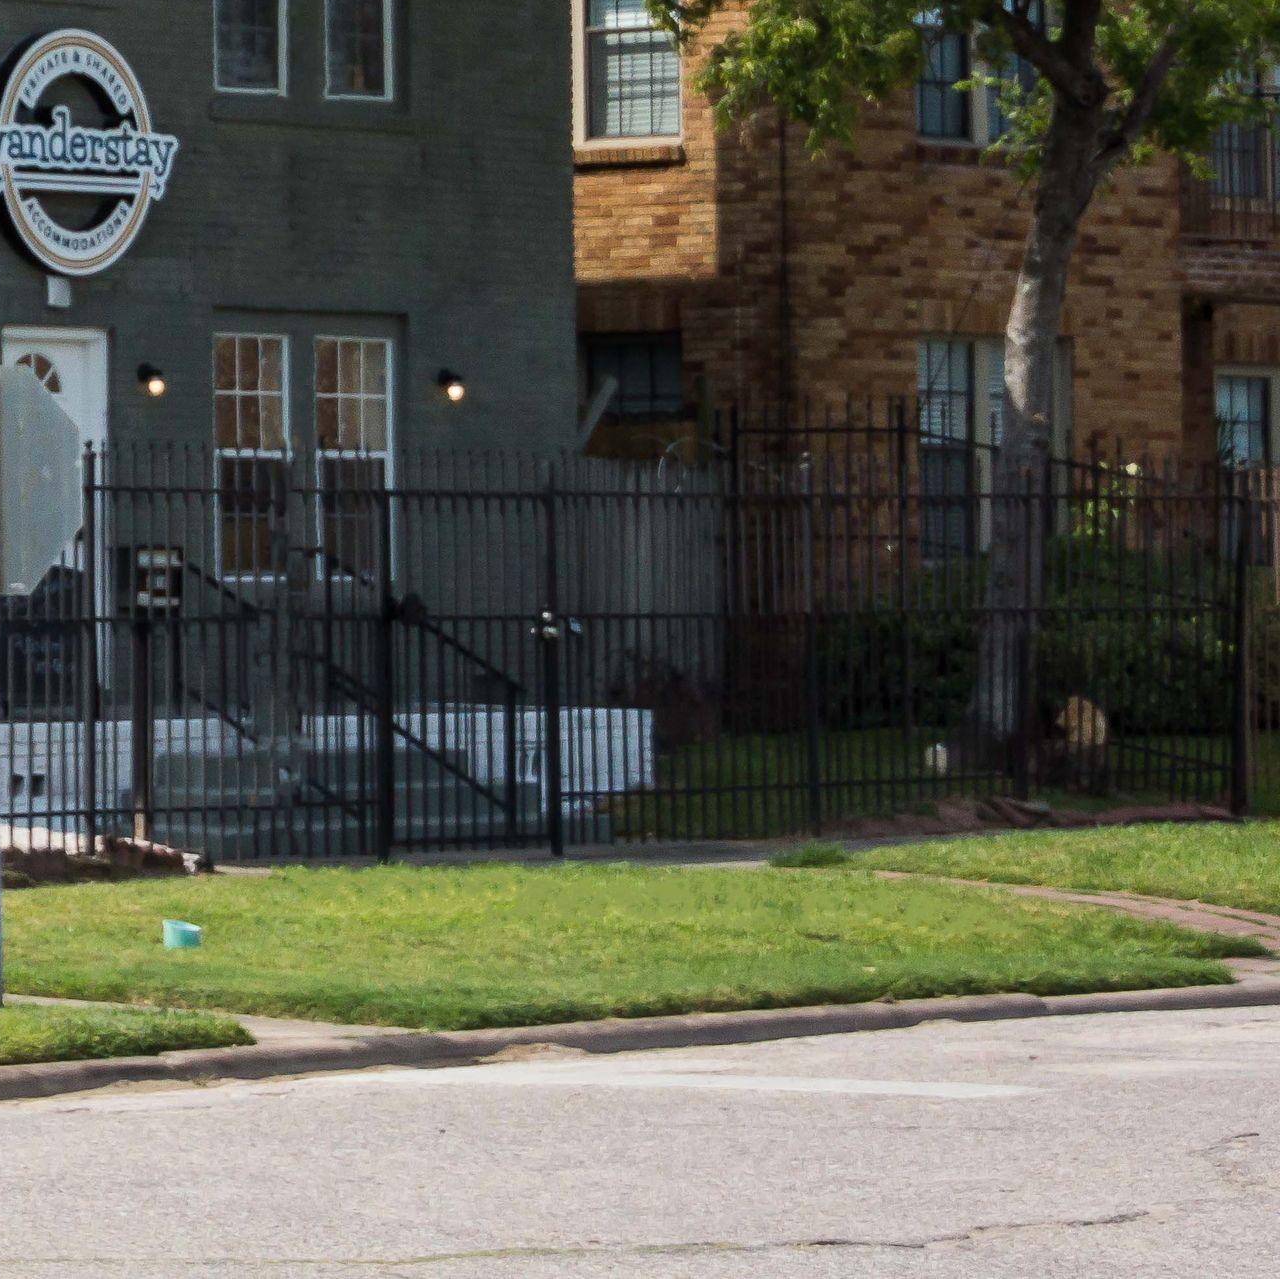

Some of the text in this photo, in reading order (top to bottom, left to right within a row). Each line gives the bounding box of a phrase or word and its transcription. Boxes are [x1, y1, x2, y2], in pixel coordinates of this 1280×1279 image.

[23, 49, 128, 106] PRIVATE & SHARED
[27, 202, 128, 252] ACCOMMODATIONS
